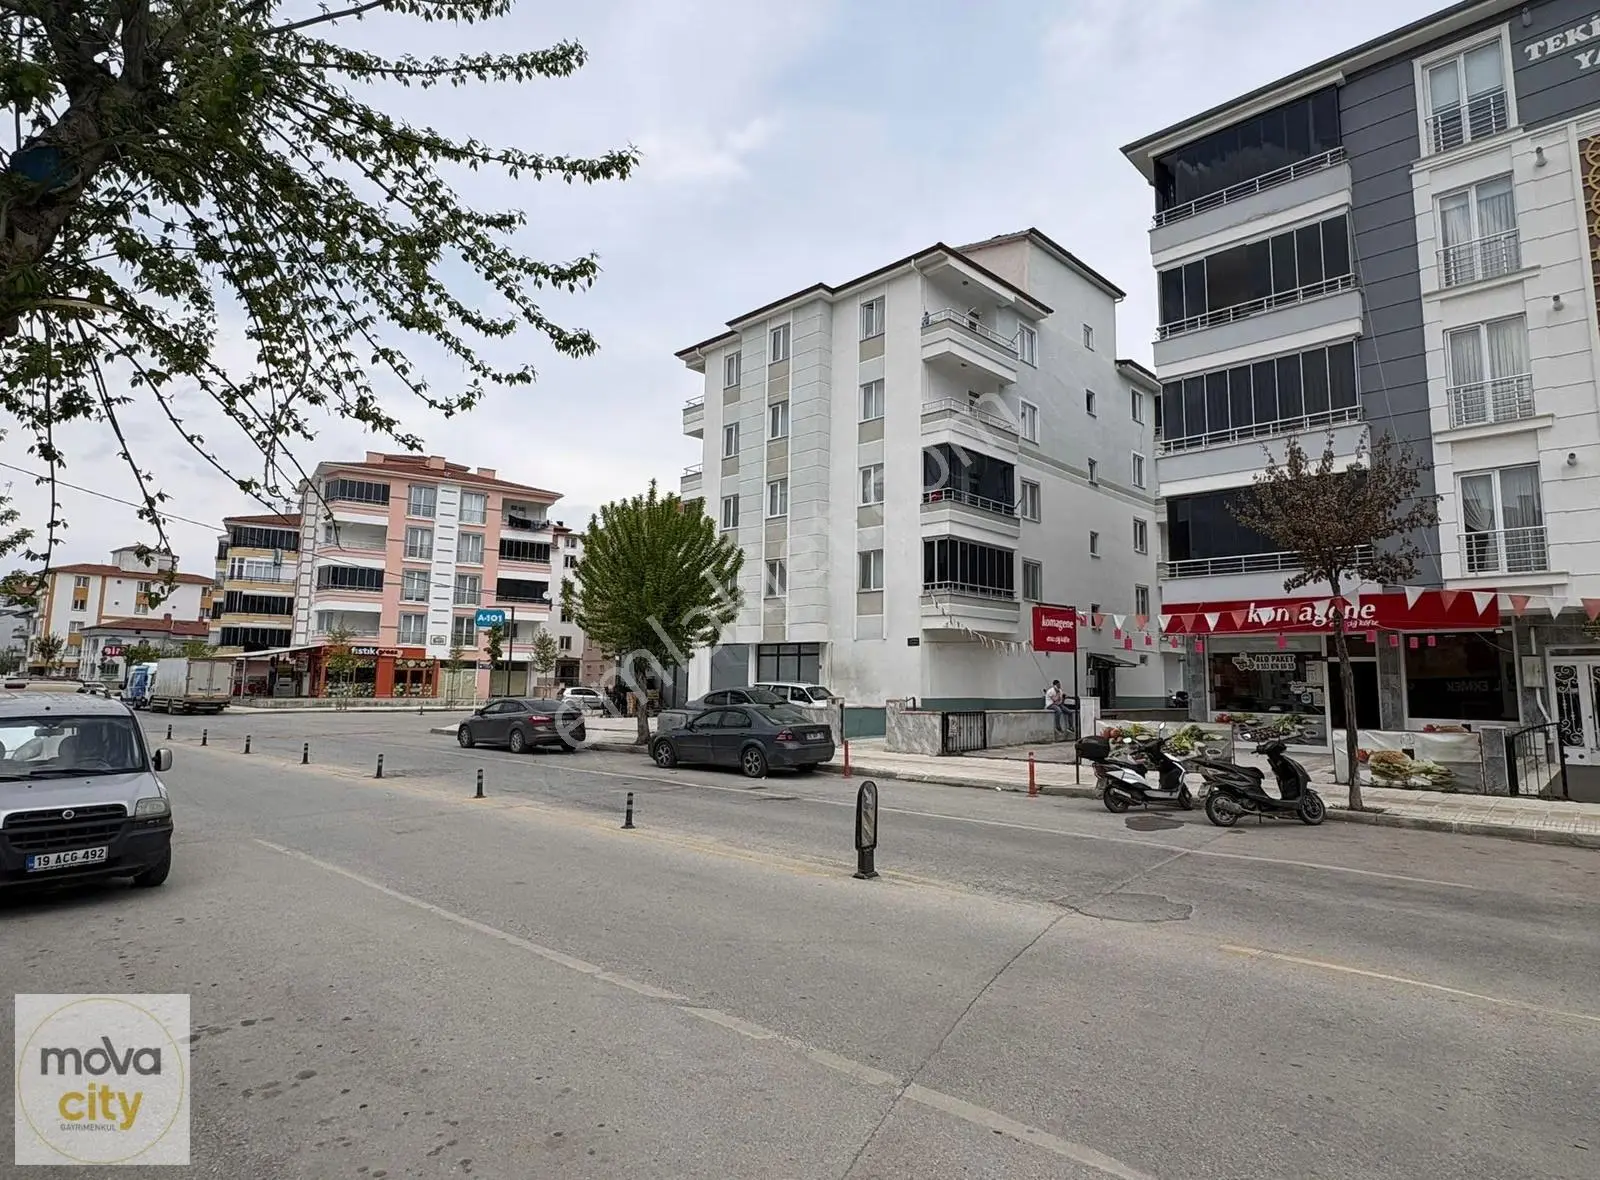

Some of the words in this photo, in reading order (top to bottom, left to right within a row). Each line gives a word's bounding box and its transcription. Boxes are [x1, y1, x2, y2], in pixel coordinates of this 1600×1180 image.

[36, 856, 50, 867] 19
[55, 852, 78, 864] ACG
[83, 848, 105, 860] 492
